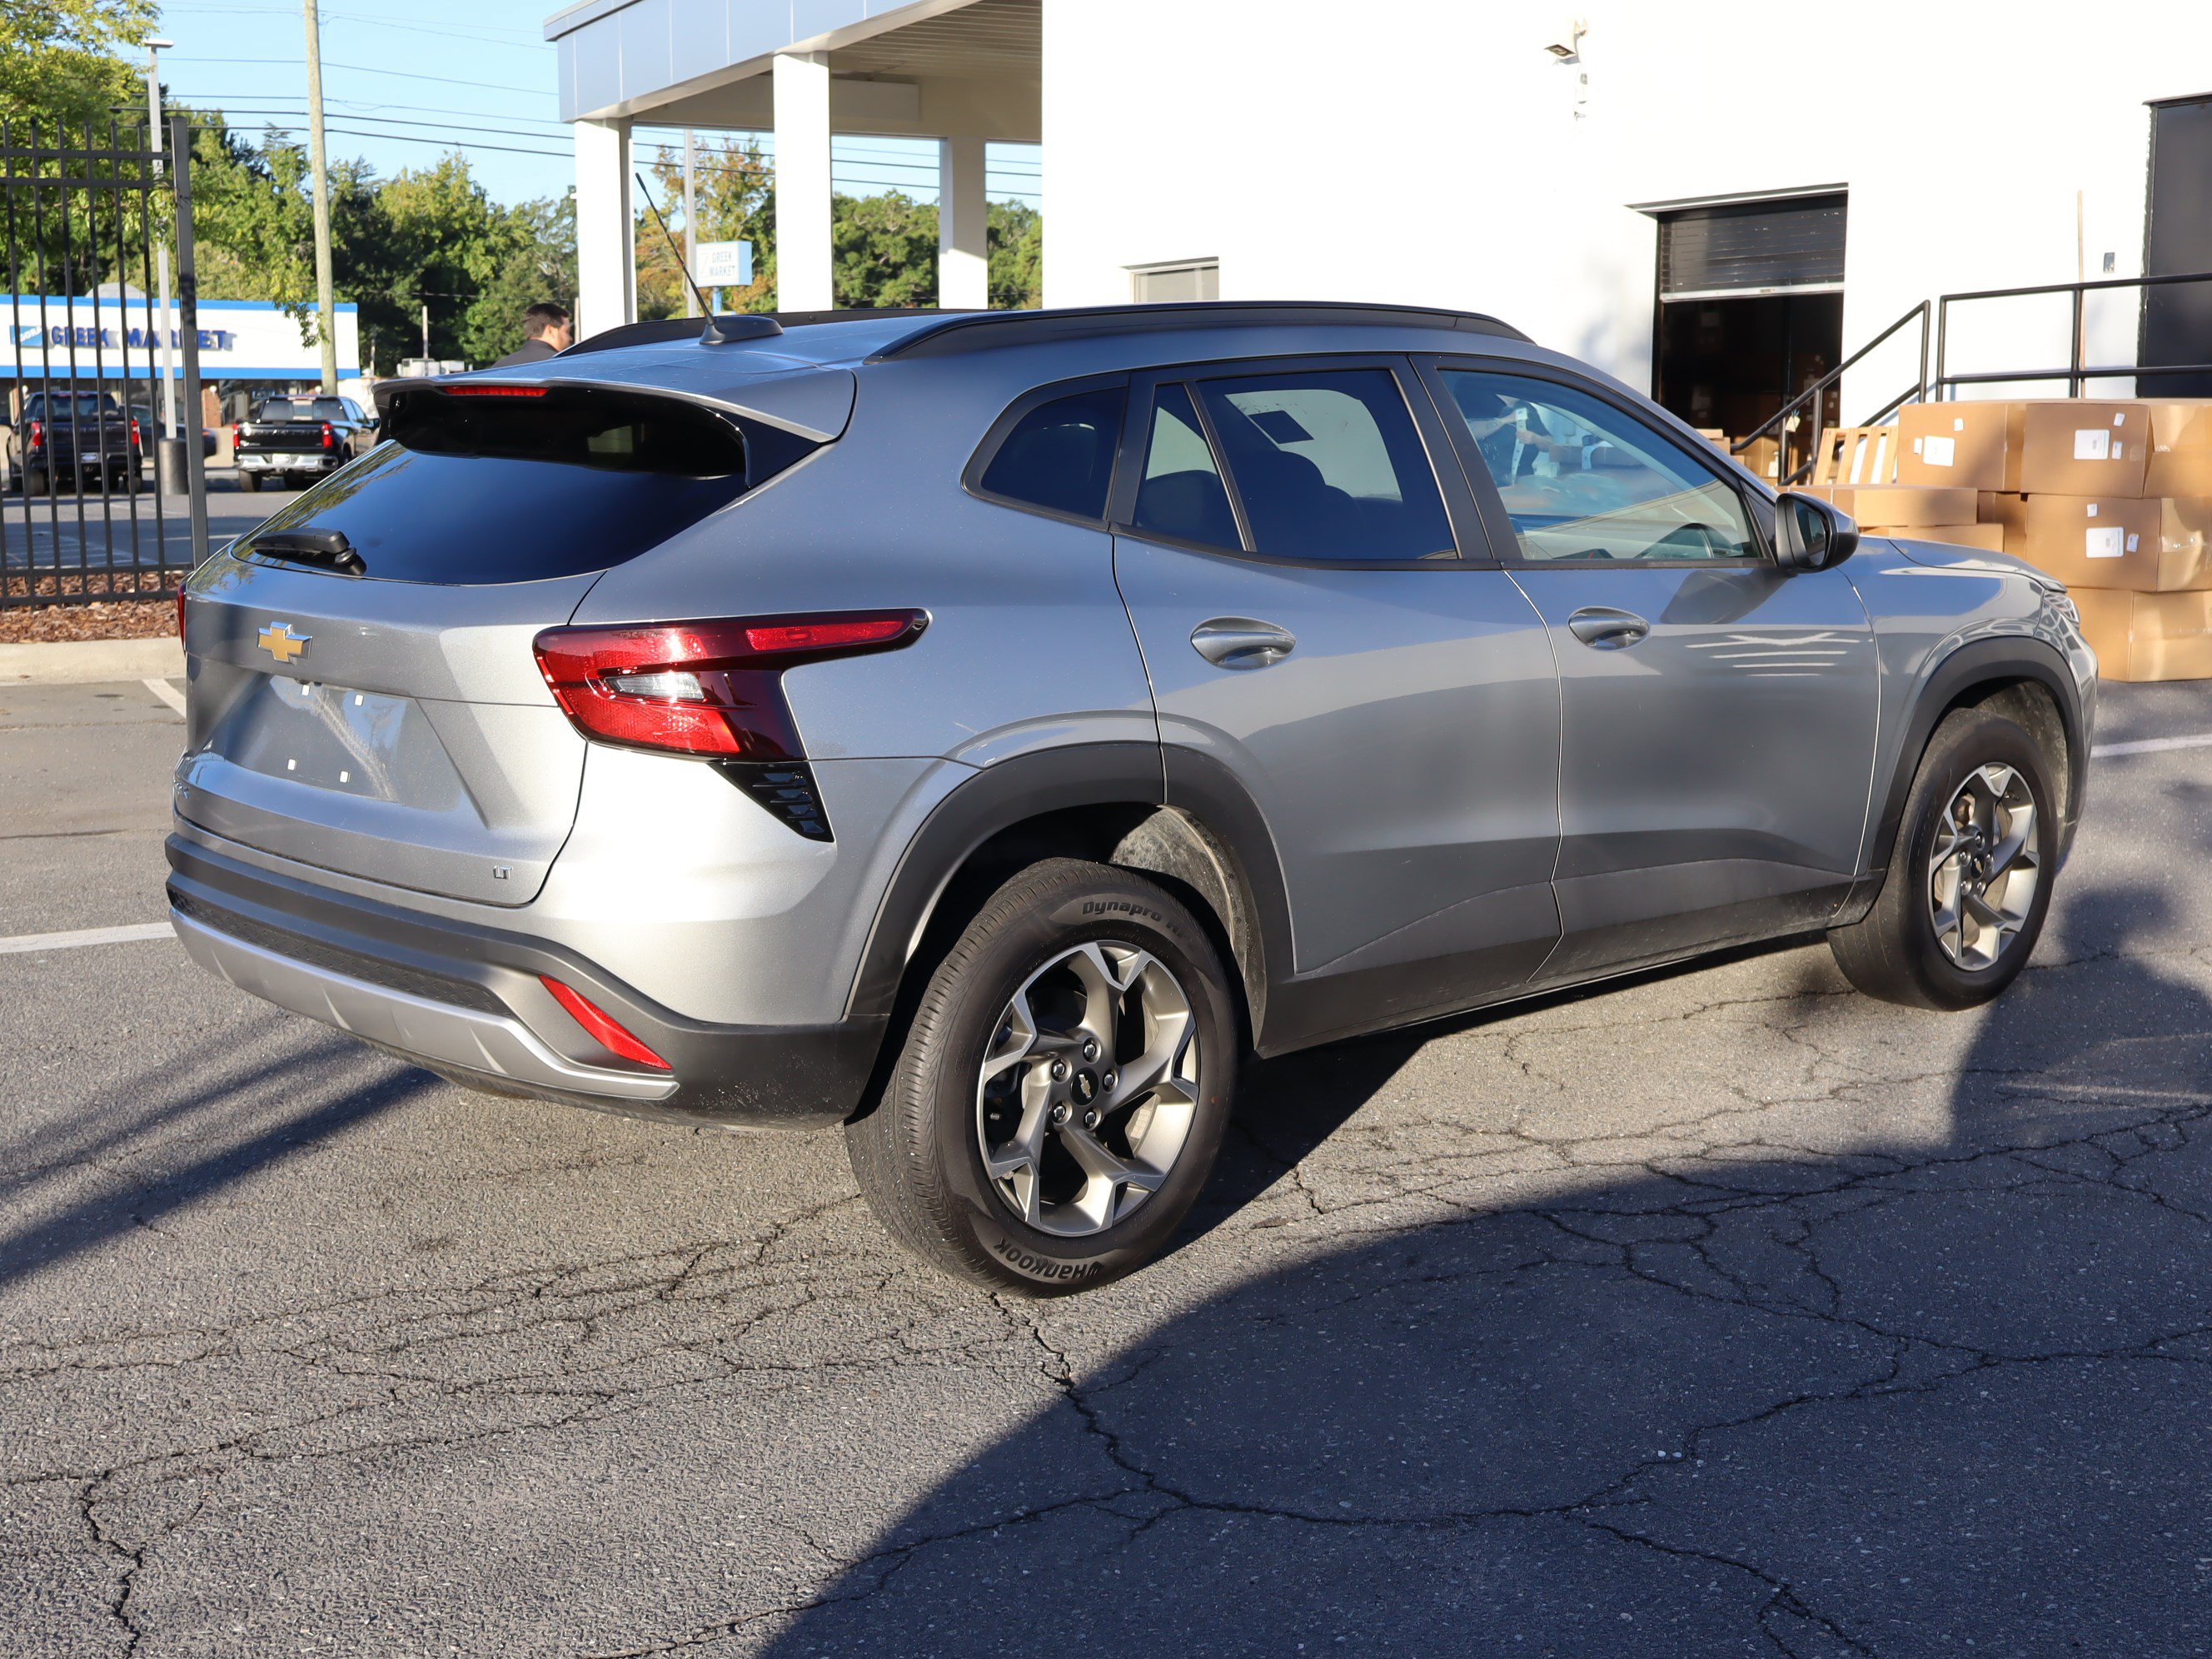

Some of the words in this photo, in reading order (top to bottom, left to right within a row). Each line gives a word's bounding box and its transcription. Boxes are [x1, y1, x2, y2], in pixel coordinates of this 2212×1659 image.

[127, 328, 227, 348] MAET
[493, 865, 513, 879] LT
[1082, 901, 1163, 922] Dynapro
